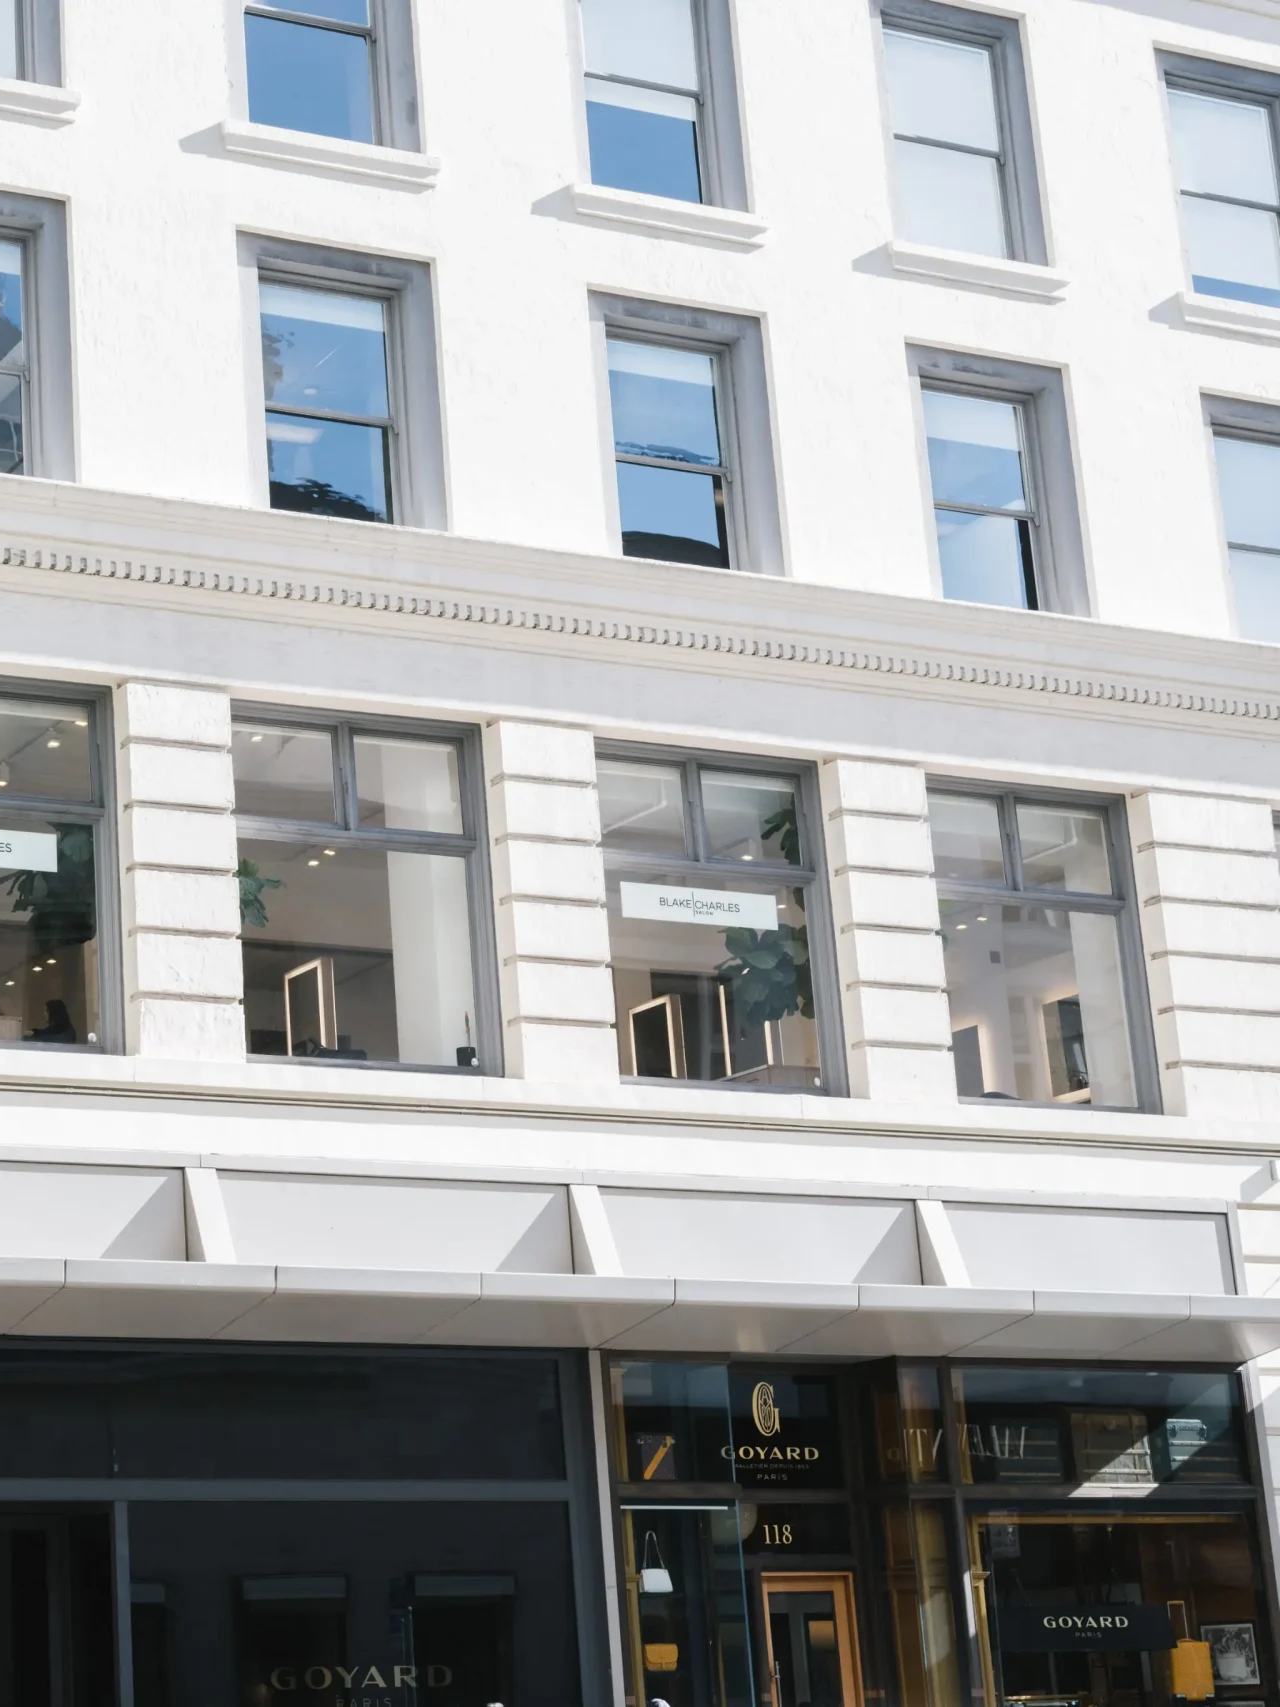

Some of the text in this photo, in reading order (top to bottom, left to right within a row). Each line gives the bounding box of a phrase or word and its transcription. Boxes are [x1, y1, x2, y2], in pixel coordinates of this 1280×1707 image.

[659, 897, 740, 912] BLAKE CHARLES
[721, 1446, 819, 1460] GOYARD
[763, 1524, 793, 1545] 118
[1043, 1616, 1129, 1628] GOYARD
[271, 1665, 453, 1690] GOYARD
